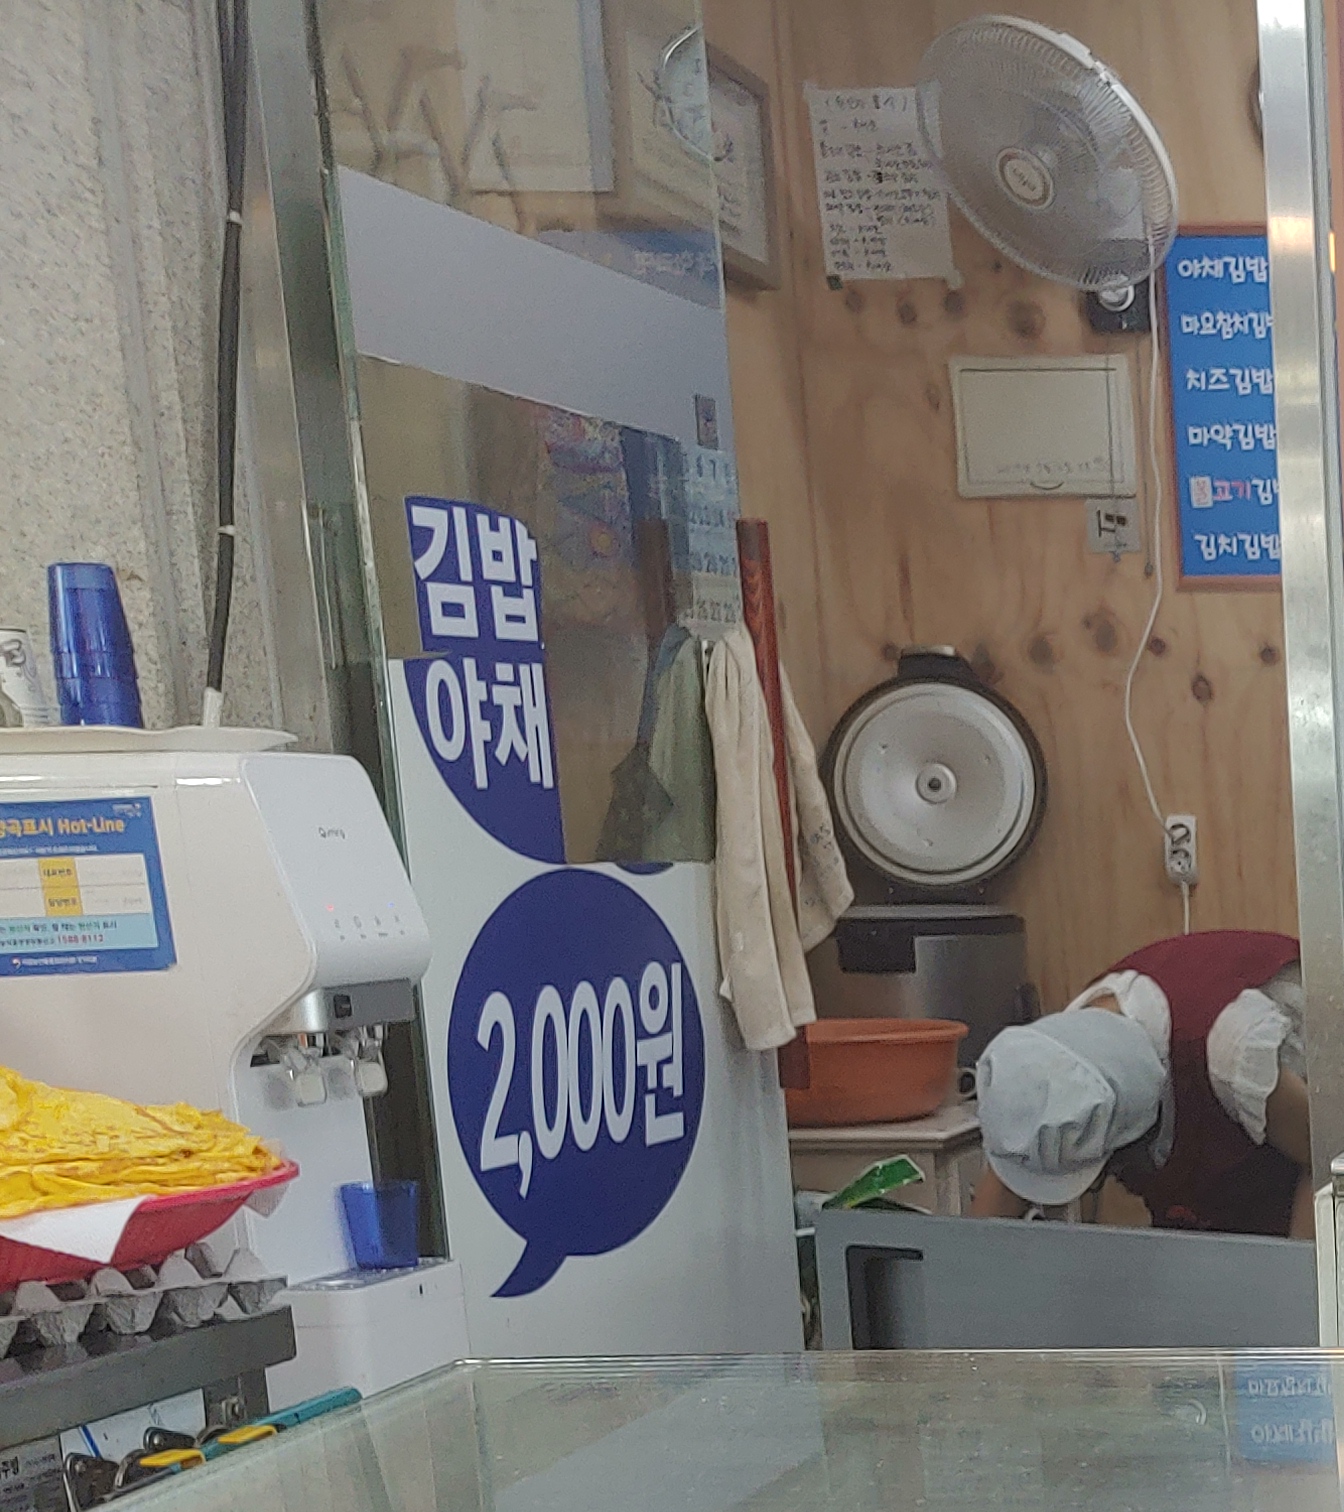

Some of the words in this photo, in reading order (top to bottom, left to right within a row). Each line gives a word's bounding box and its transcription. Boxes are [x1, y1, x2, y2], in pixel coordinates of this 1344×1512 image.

[1186, 368, 1274, 396] 치즈김밥
[1188, 424, 1277, 451] 마약김밥
[1194, 477, 1279, 506] 불고기김
[411, 505, 538, 642] 김밥
[425, 657, 556, 790] 야채
[478, 961, 687, 1198] 2,000원
